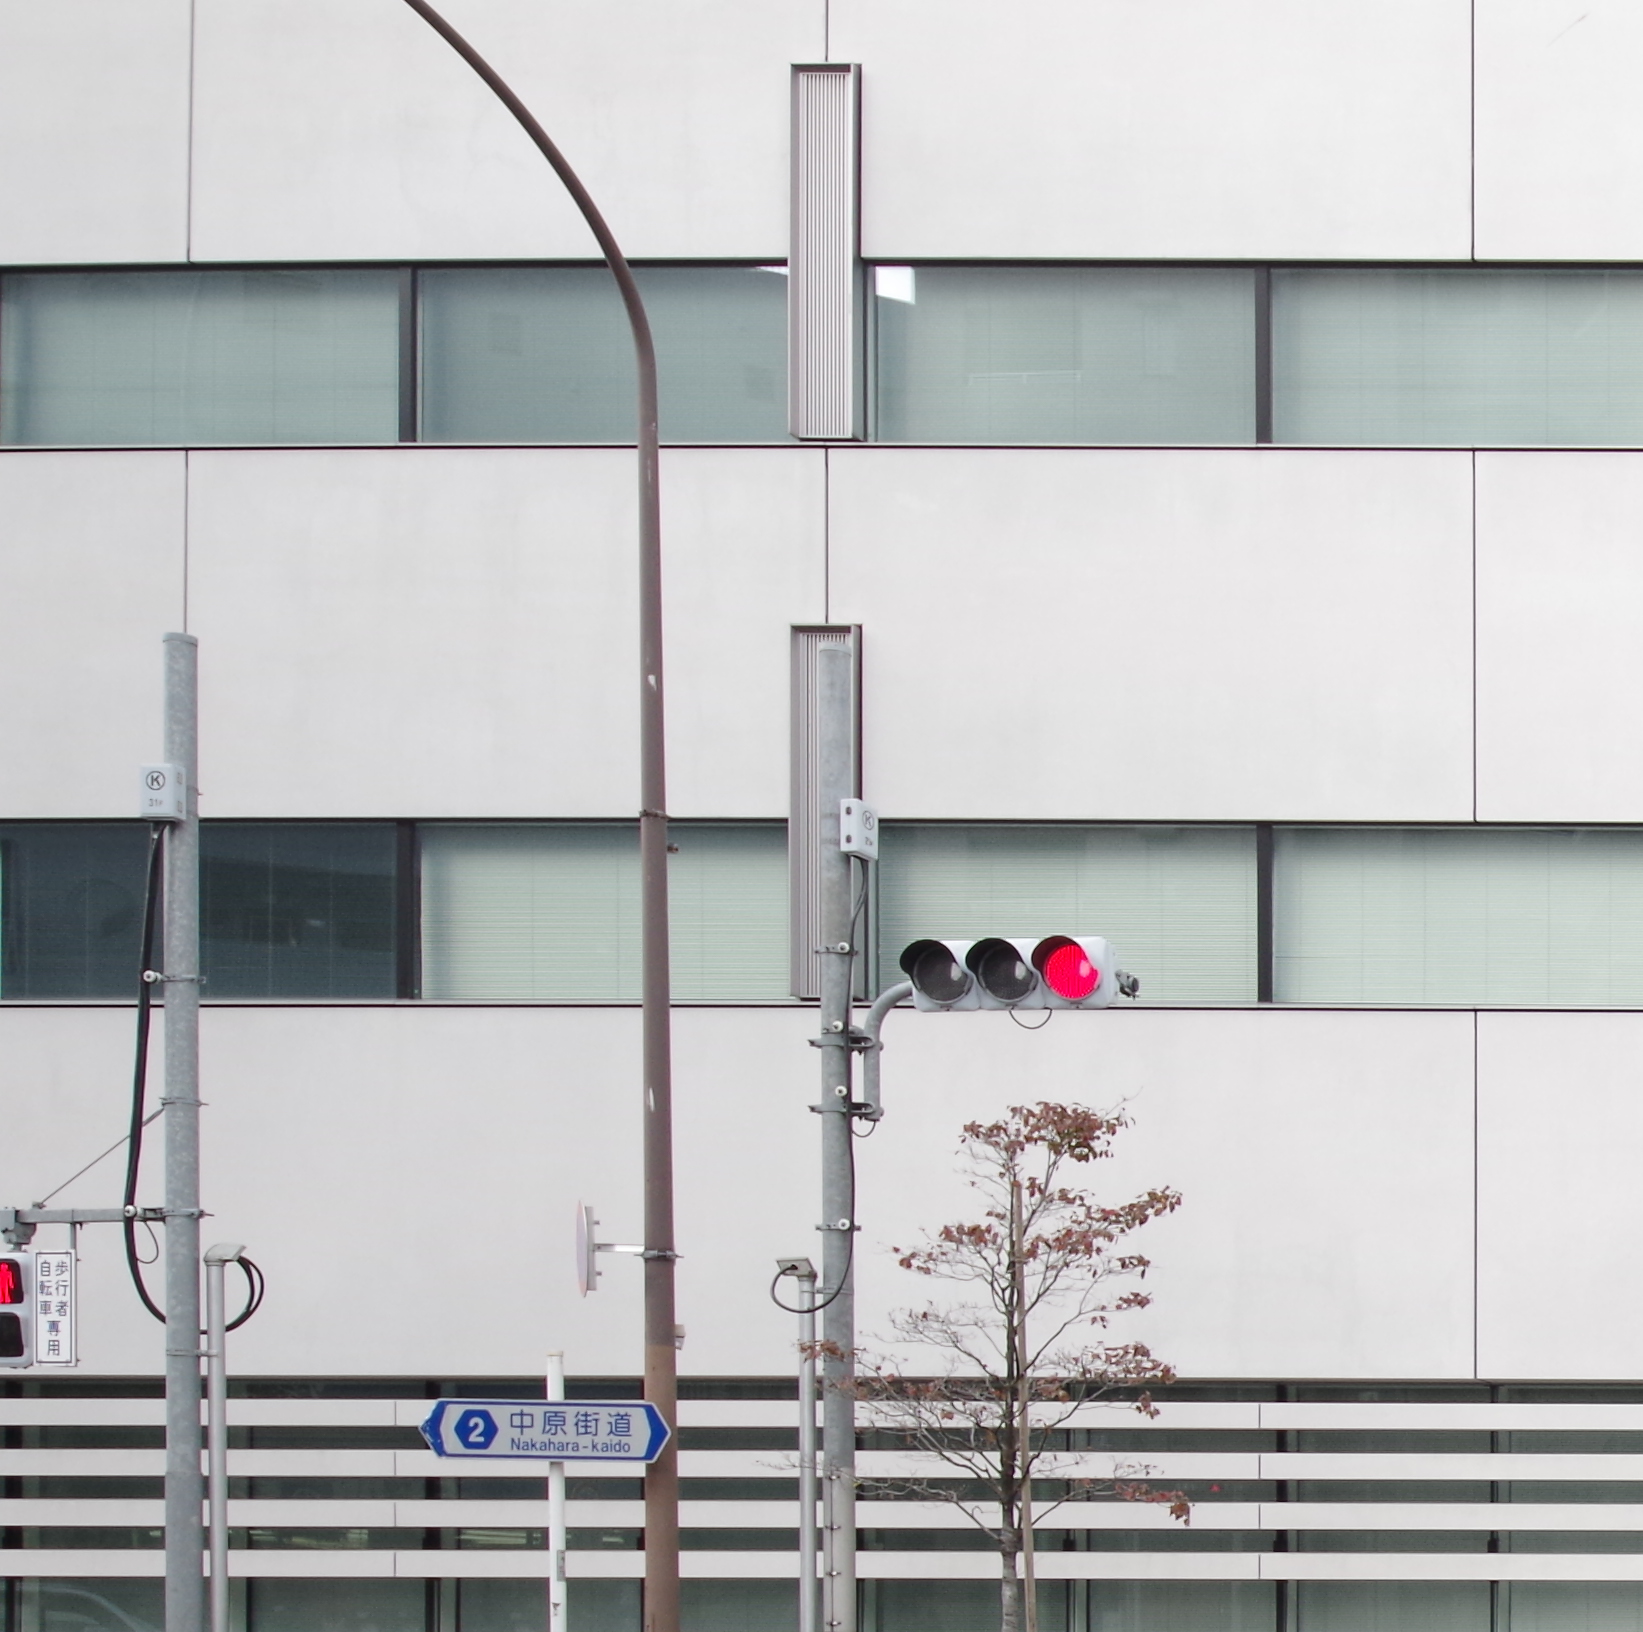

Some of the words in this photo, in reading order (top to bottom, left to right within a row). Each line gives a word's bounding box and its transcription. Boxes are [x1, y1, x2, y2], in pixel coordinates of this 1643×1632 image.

[40, 1261, 52, 1315] 自転車
[55, 1261, 69, 1316] 歩行者
[47, 1321, 61, 1356] 専用
[468, 1417, 485, 1443] 2
[510, 1409, 632, 1437] 中原街道
